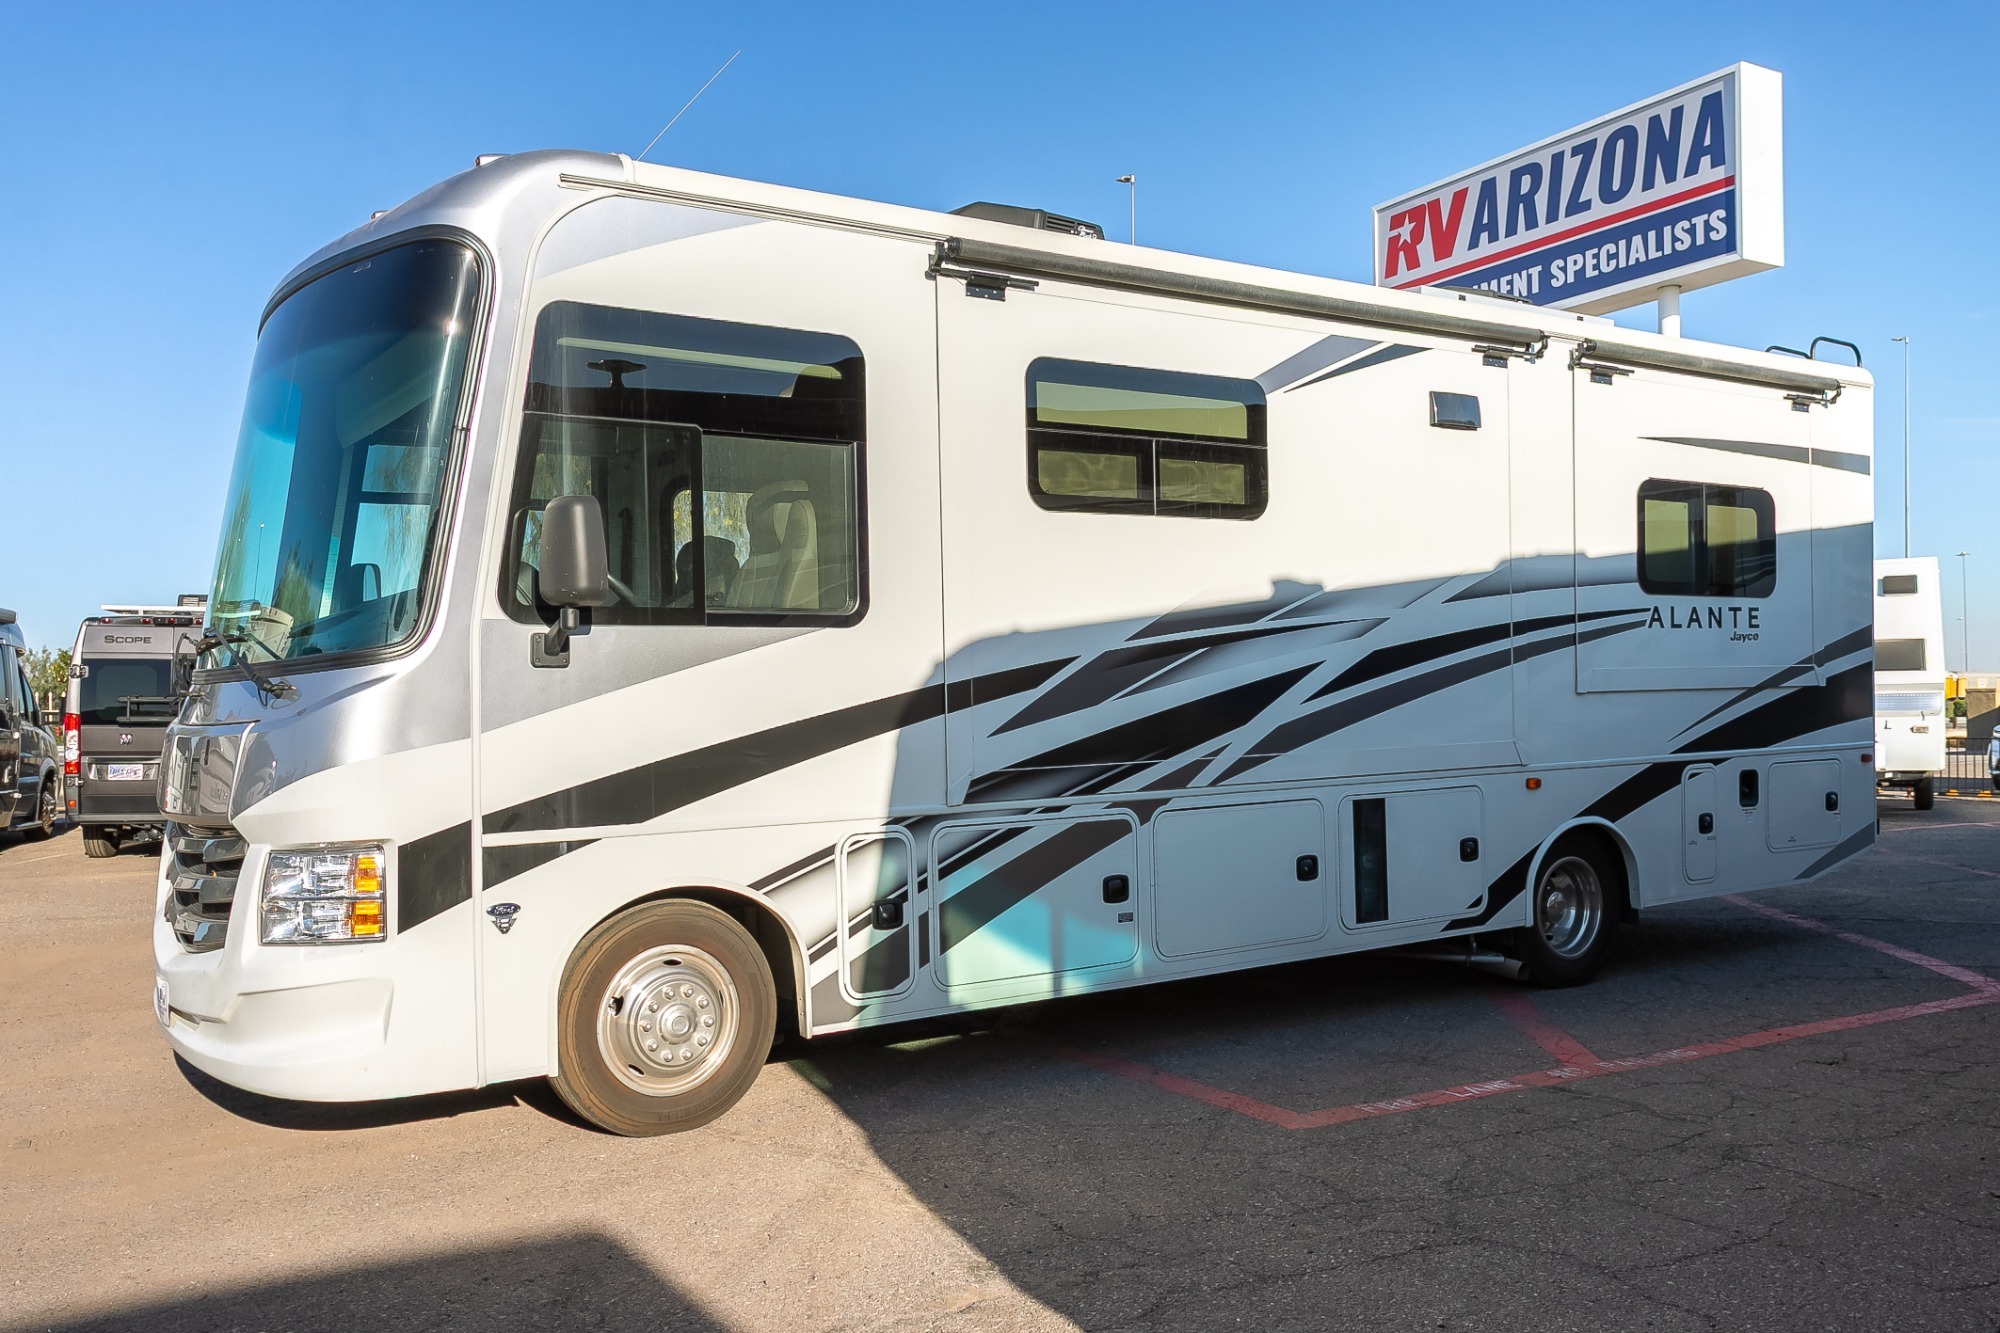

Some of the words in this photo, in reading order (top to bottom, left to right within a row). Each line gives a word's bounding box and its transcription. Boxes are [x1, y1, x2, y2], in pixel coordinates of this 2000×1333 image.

[1467, 91, 1726, 251] ARIZONA
[1551, 209, 1727, 287] SPECIALISTS
[1648, 606, 1760, 628] ALANTE
[104, 635, 152, 644] SCOPE
[1729, 631, 1759, 643] Jayco
